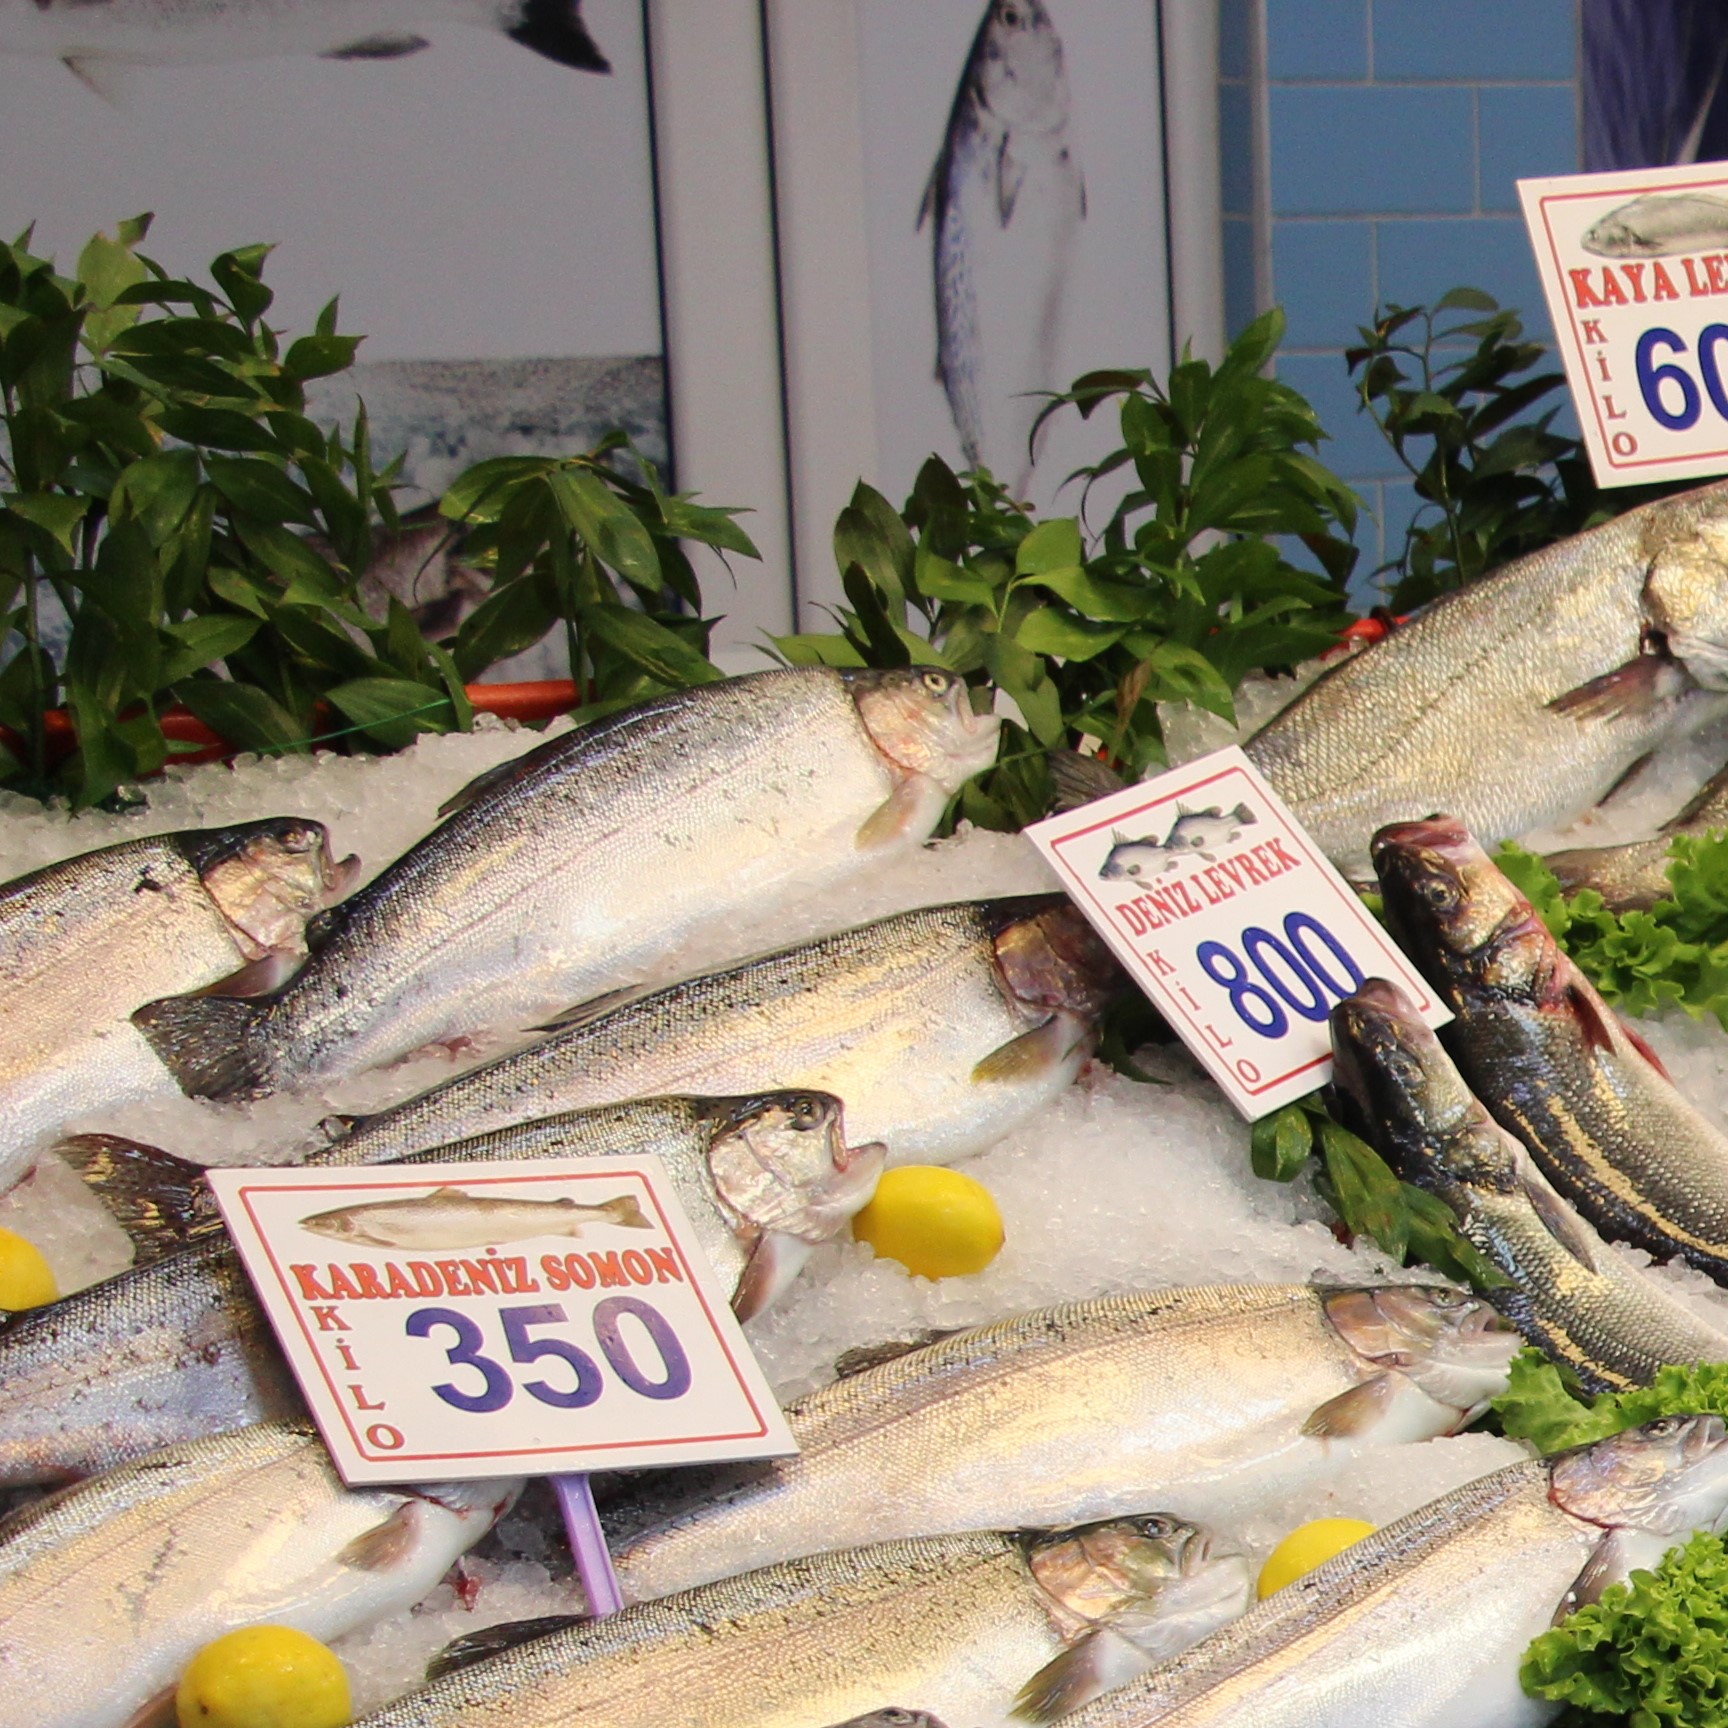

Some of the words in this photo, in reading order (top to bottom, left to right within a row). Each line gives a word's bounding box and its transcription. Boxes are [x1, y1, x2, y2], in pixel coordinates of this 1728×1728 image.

[1568, 261, 1680, 309] KAYA
[1581, 318, 1638, 456] KİLO
[1115, 877, 1199, 937] DENİZ
[1195, 838, 1301, 904] LEVREK
[1146, 949, 1261, 1084] KİLO
[1196, 911, 1366, 1039] 800
[290, 1248, 538, 1301] KARADENİZ
[546, 1246, 684, 1293] SOMON
[315, 1306, 405, 1450] KİLO
[405, 1296, 693, 1414] 350
